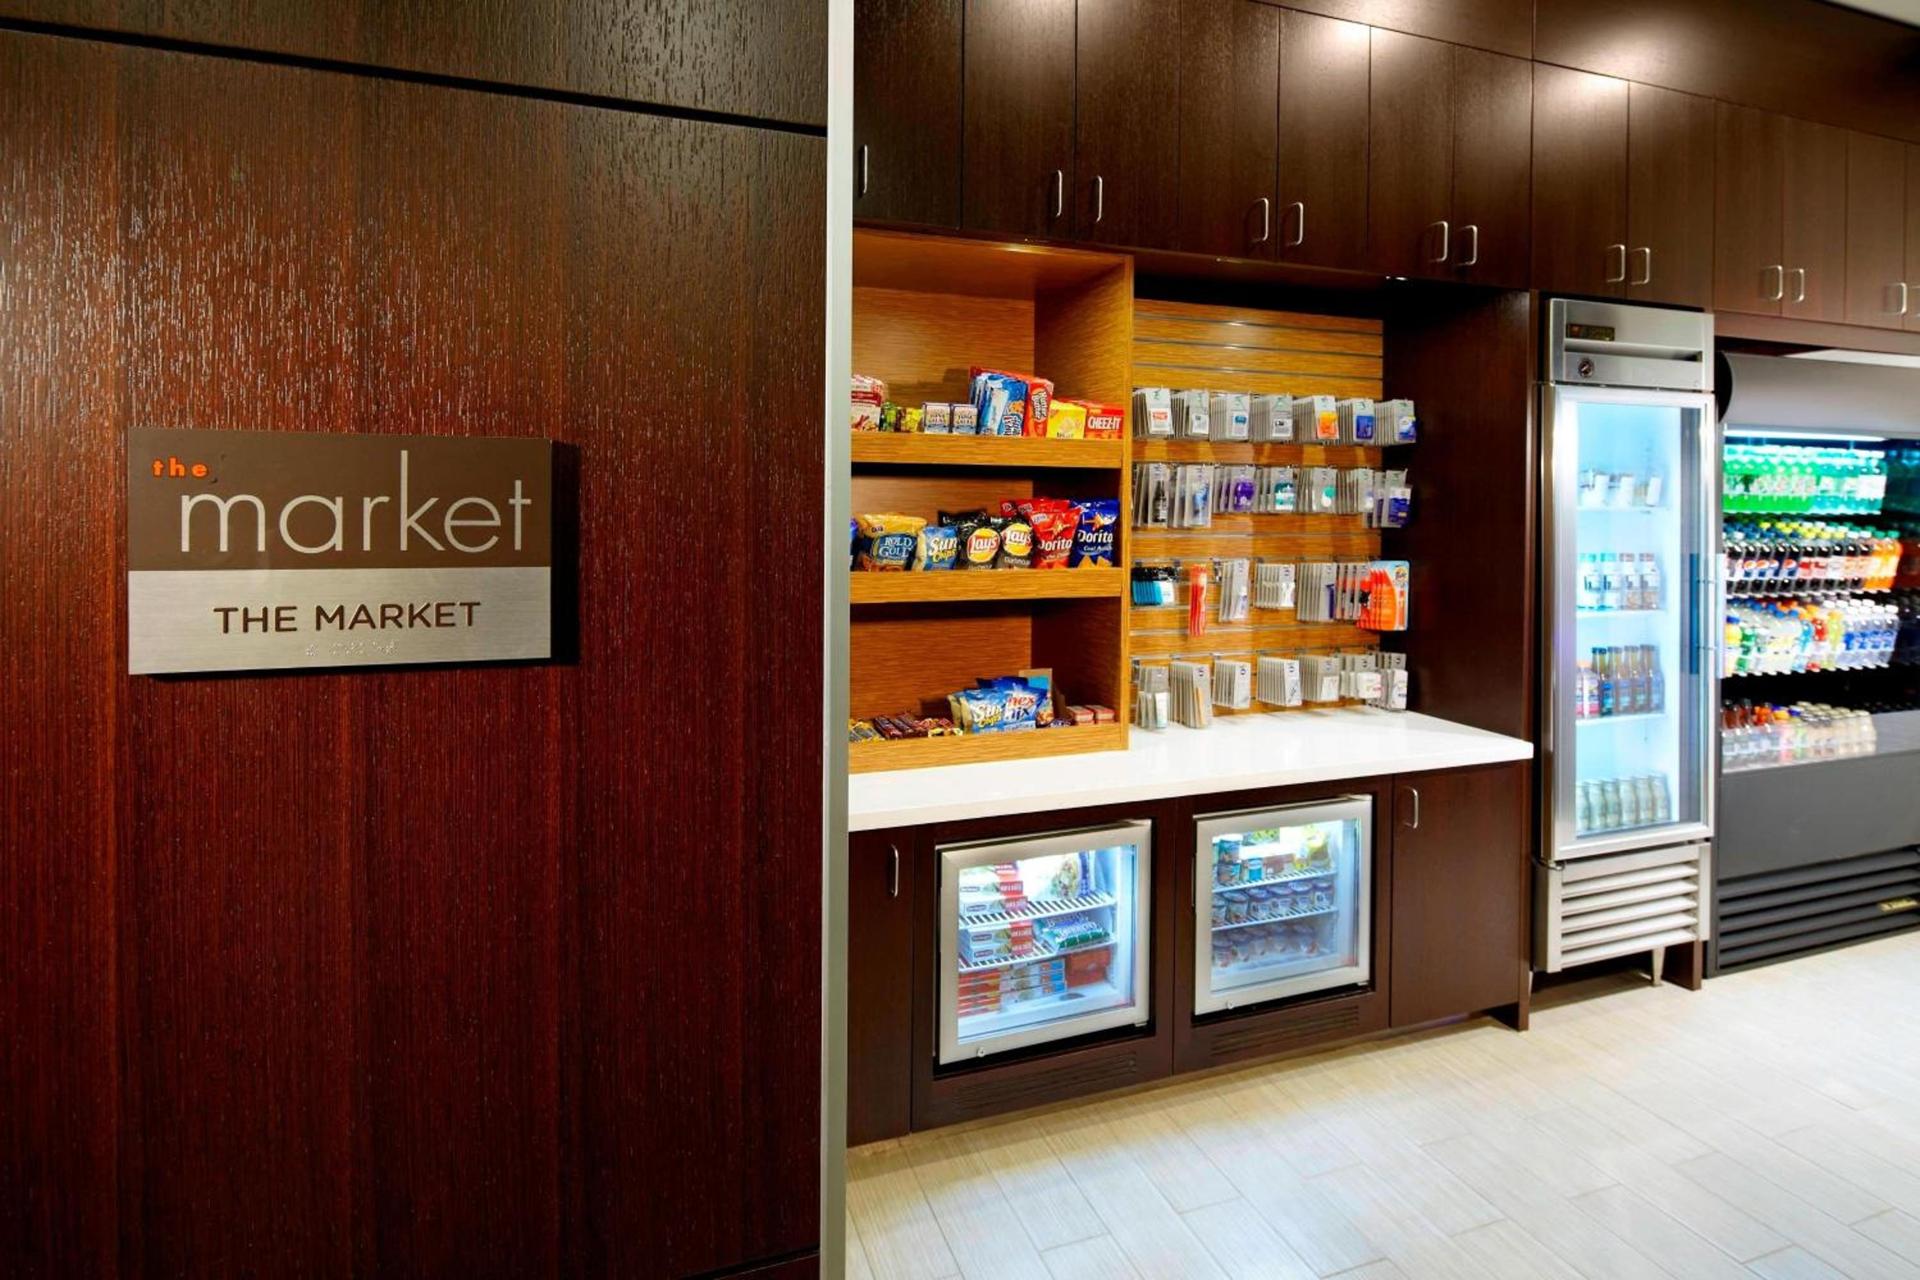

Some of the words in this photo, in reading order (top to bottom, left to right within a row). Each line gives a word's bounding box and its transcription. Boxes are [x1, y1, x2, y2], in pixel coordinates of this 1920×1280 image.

[152, 457, 209, 479] the
[180, 449, 532, 554] market
[213, 606, 298, 634] THE
[315, 601, 481, 631] MARKET
